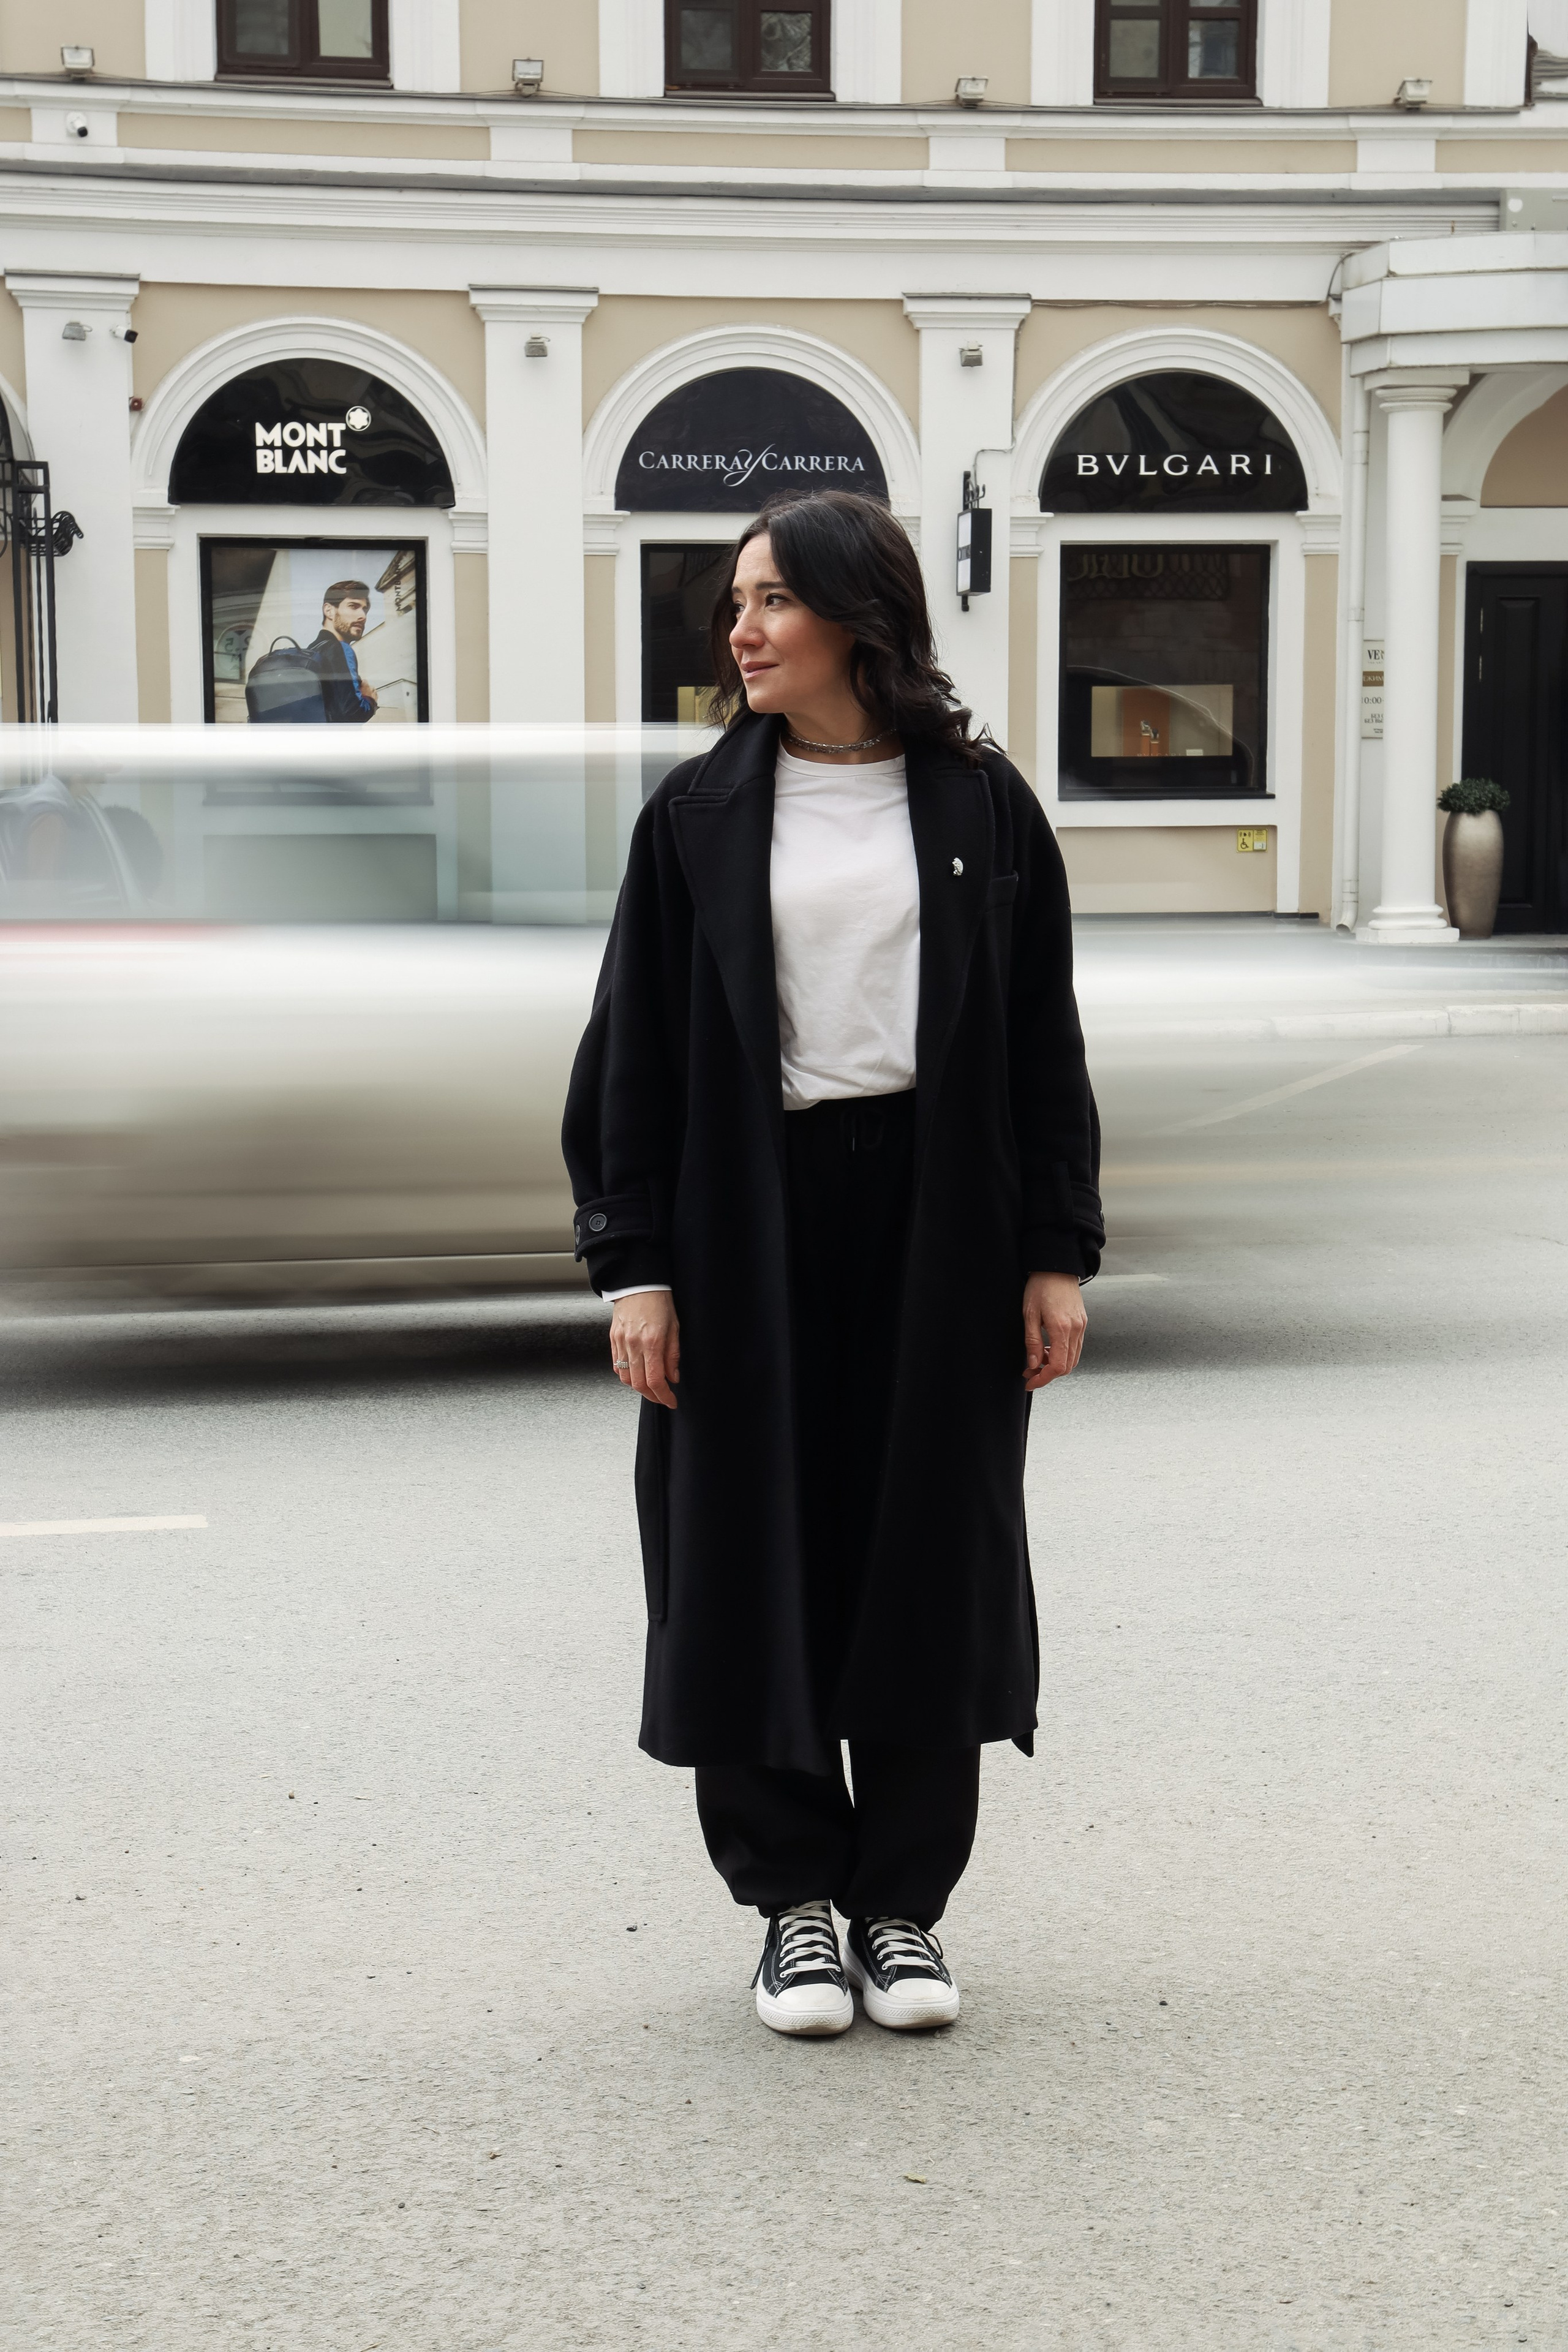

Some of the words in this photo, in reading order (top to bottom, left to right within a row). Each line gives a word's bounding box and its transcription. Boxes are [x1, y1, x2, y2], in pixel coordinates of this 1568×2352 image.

[255, 421, 346, 447] MONT
[255, 448, 347, 474] BLANC
[639, 451, 744, 472] CARRERA
[761, 452, 865, 473] CARRERA
[1077, 454, 1272, 475] BVLGARI
